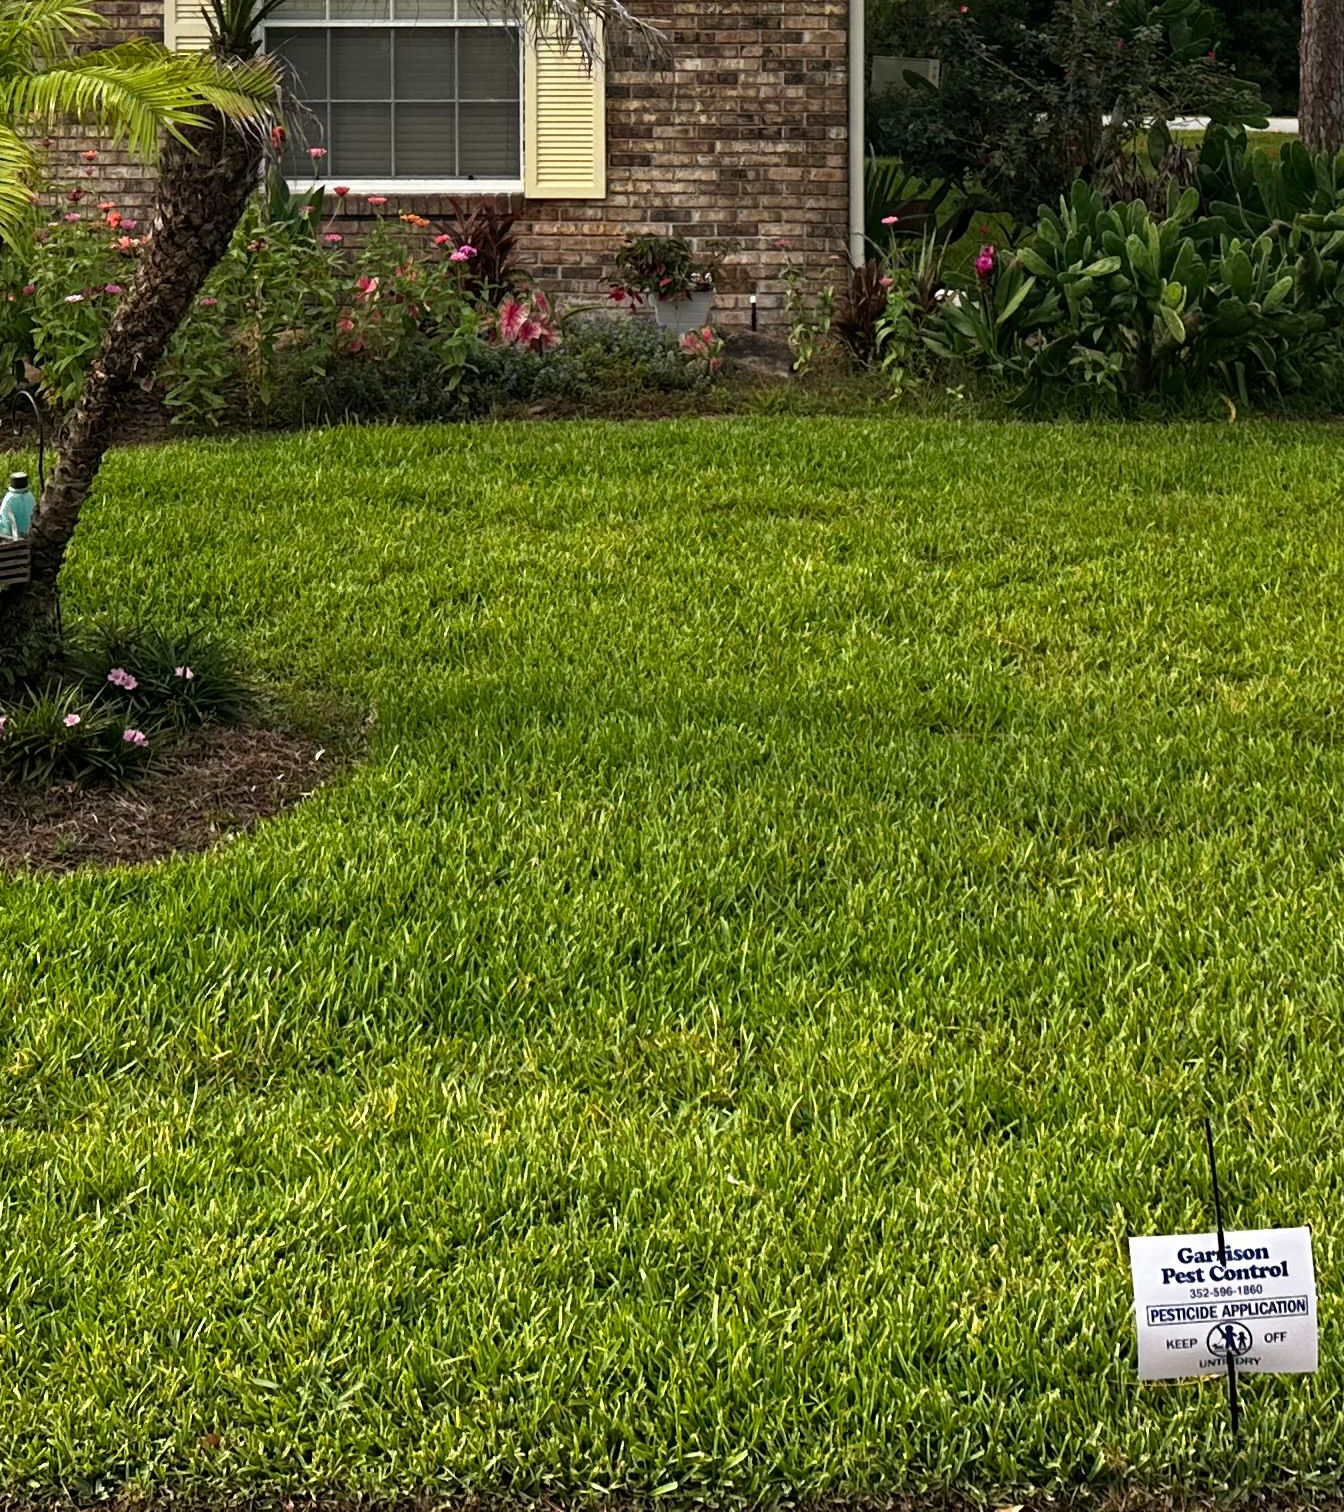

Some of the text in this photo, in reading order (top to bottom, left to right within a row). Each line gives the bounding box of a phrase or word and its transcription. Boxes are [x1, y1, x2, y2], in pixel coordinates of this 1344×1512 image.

[1161, 1260, 1289, 1285] Pest Control
[1189, 1284, 1263, 1299] 352-596-1860
[1150, 1298, 1306, 1323] PESTICIDE APPLICATION
[1166, 1331, 1287, 1350] KEEP OFF
[1199, 1357, 1261, 1369] UNTI DRY
